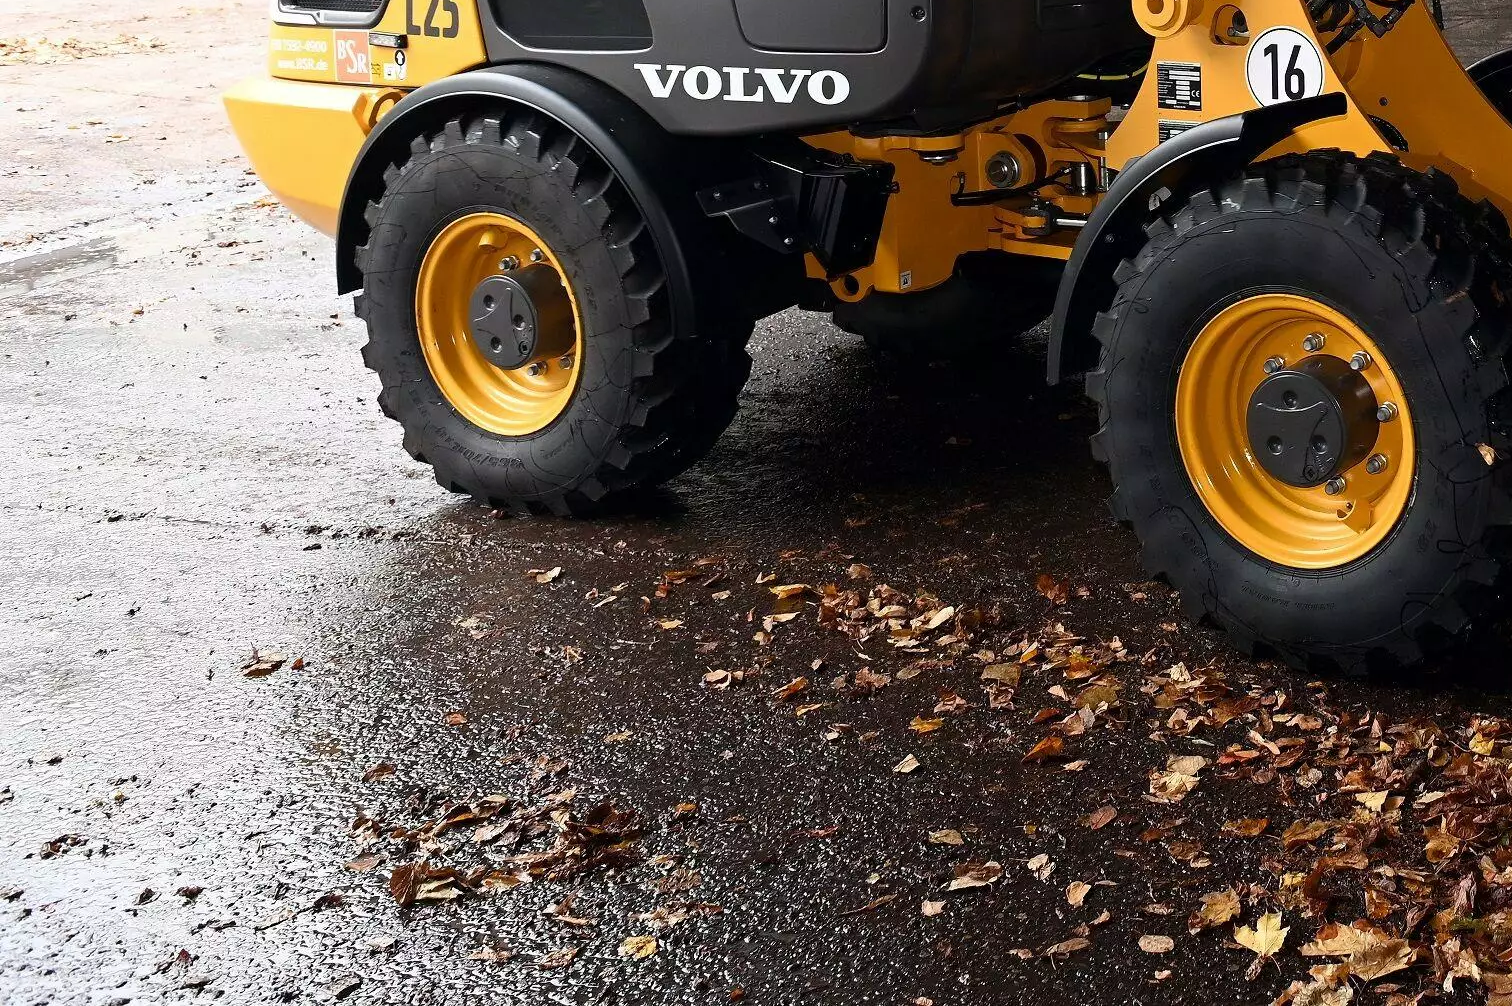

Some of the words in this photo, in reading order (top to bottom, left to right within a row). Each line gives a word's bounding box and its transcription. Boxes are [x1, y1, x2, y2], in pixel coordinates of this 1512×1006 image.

[337, 39, 369, 74] BSR
[1264, 43, 1305, 100] 16
[634, 63, 850, 105] VOLVO
